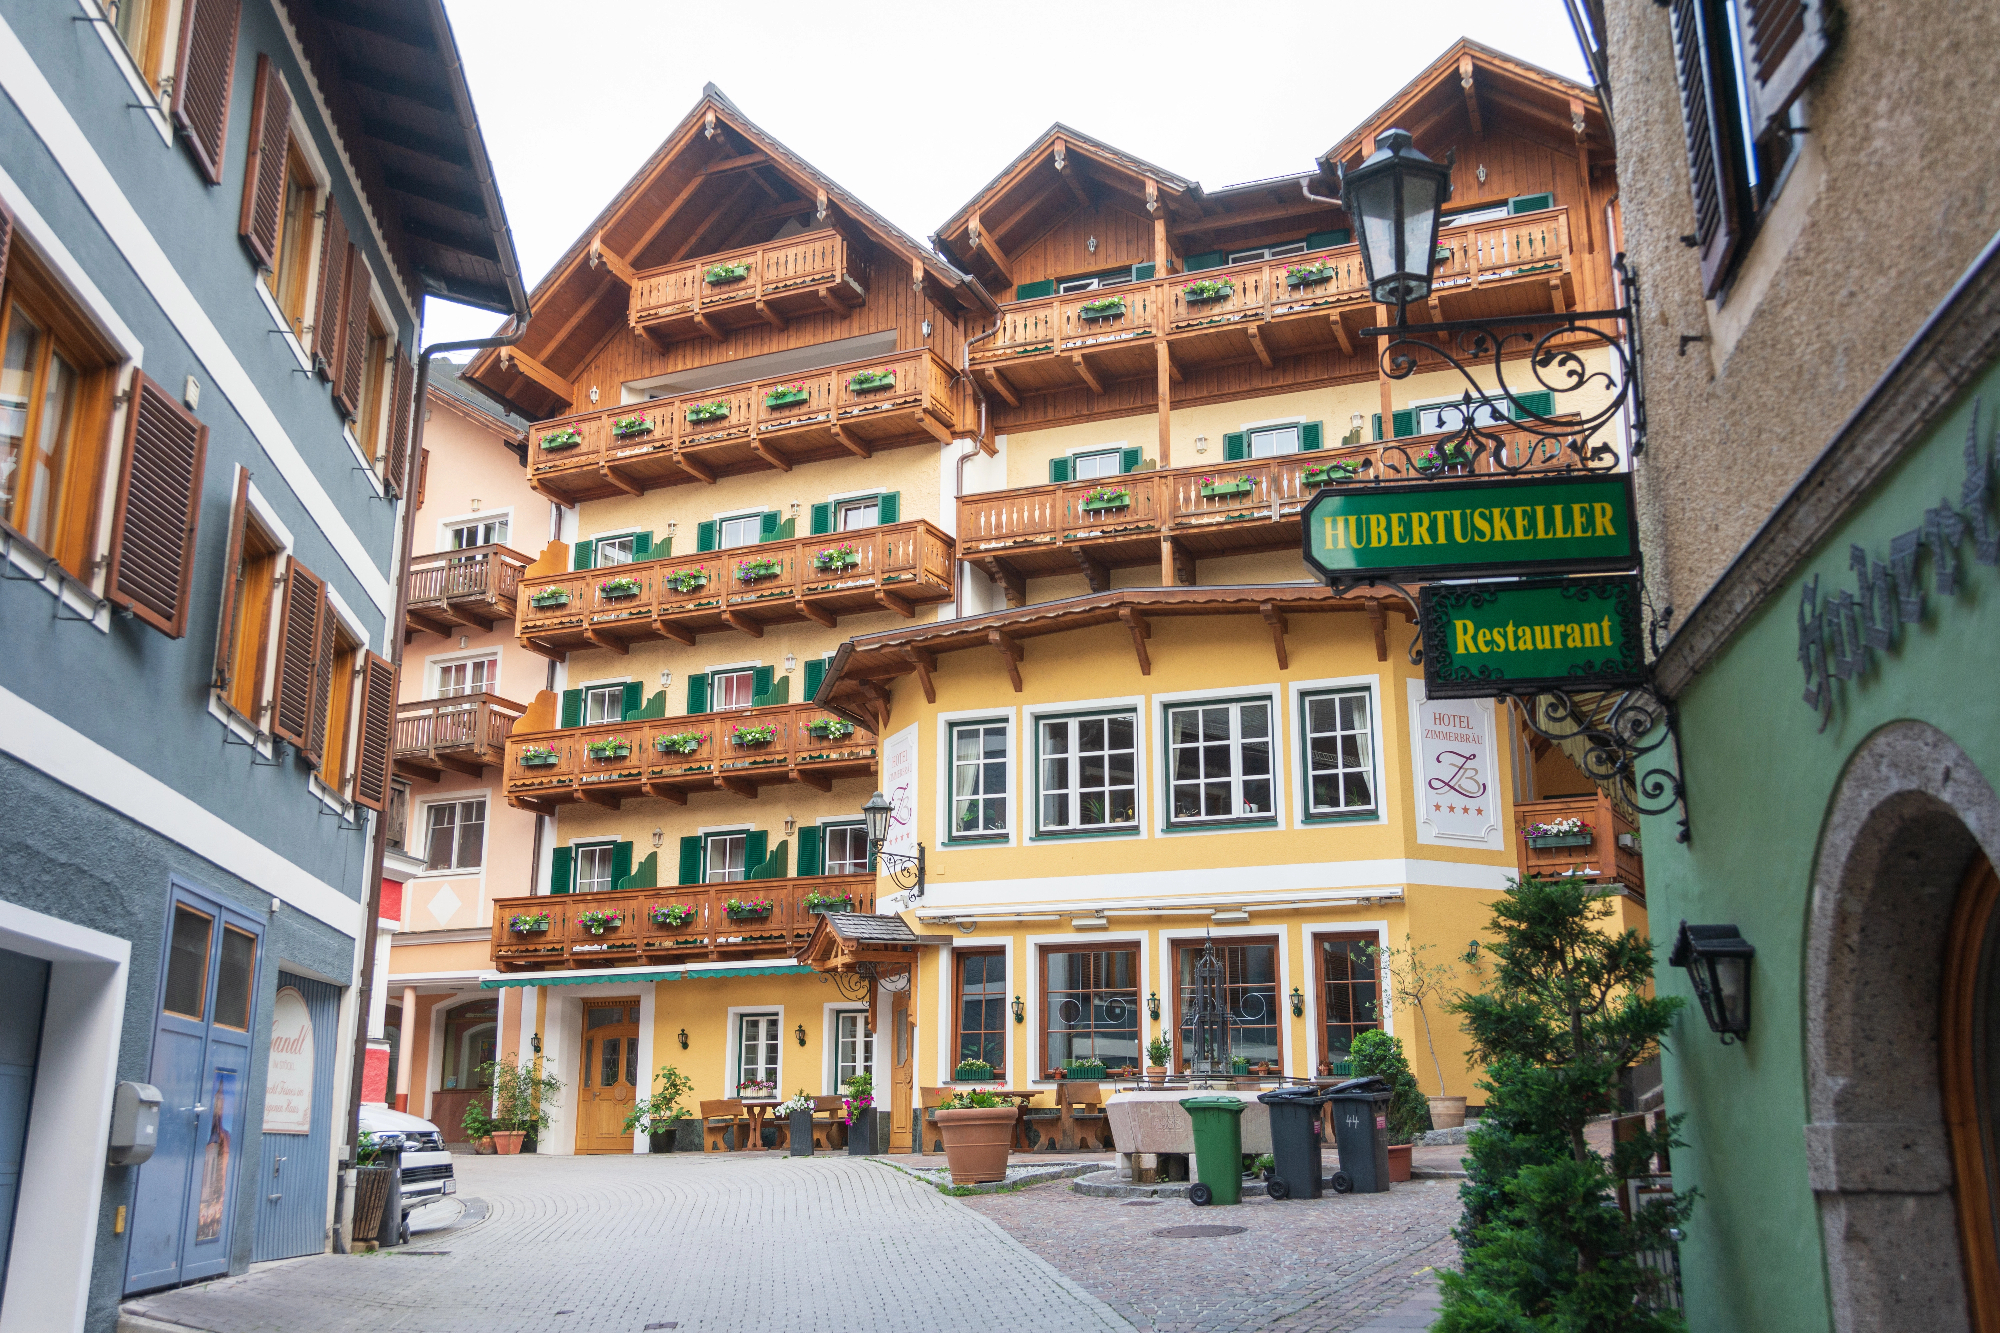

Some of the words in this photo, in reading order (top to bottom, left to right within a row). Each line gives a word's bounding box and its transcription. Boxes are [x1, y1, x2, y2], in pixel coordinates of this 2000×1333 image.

[1323, 502, 1617, 550] HUBERTUSKELLER
[1453, 614, 1613, 655] Restaurant
[1432, 711, 1474, 730] HOTEL
[1424, 728, 1483, 745] ZIMMERBRÄU
[891, 749, 908, 769] HOTEL
[269, 1019, 313, 1056] andl
[1346, 1114, 1360, 1129] 44
